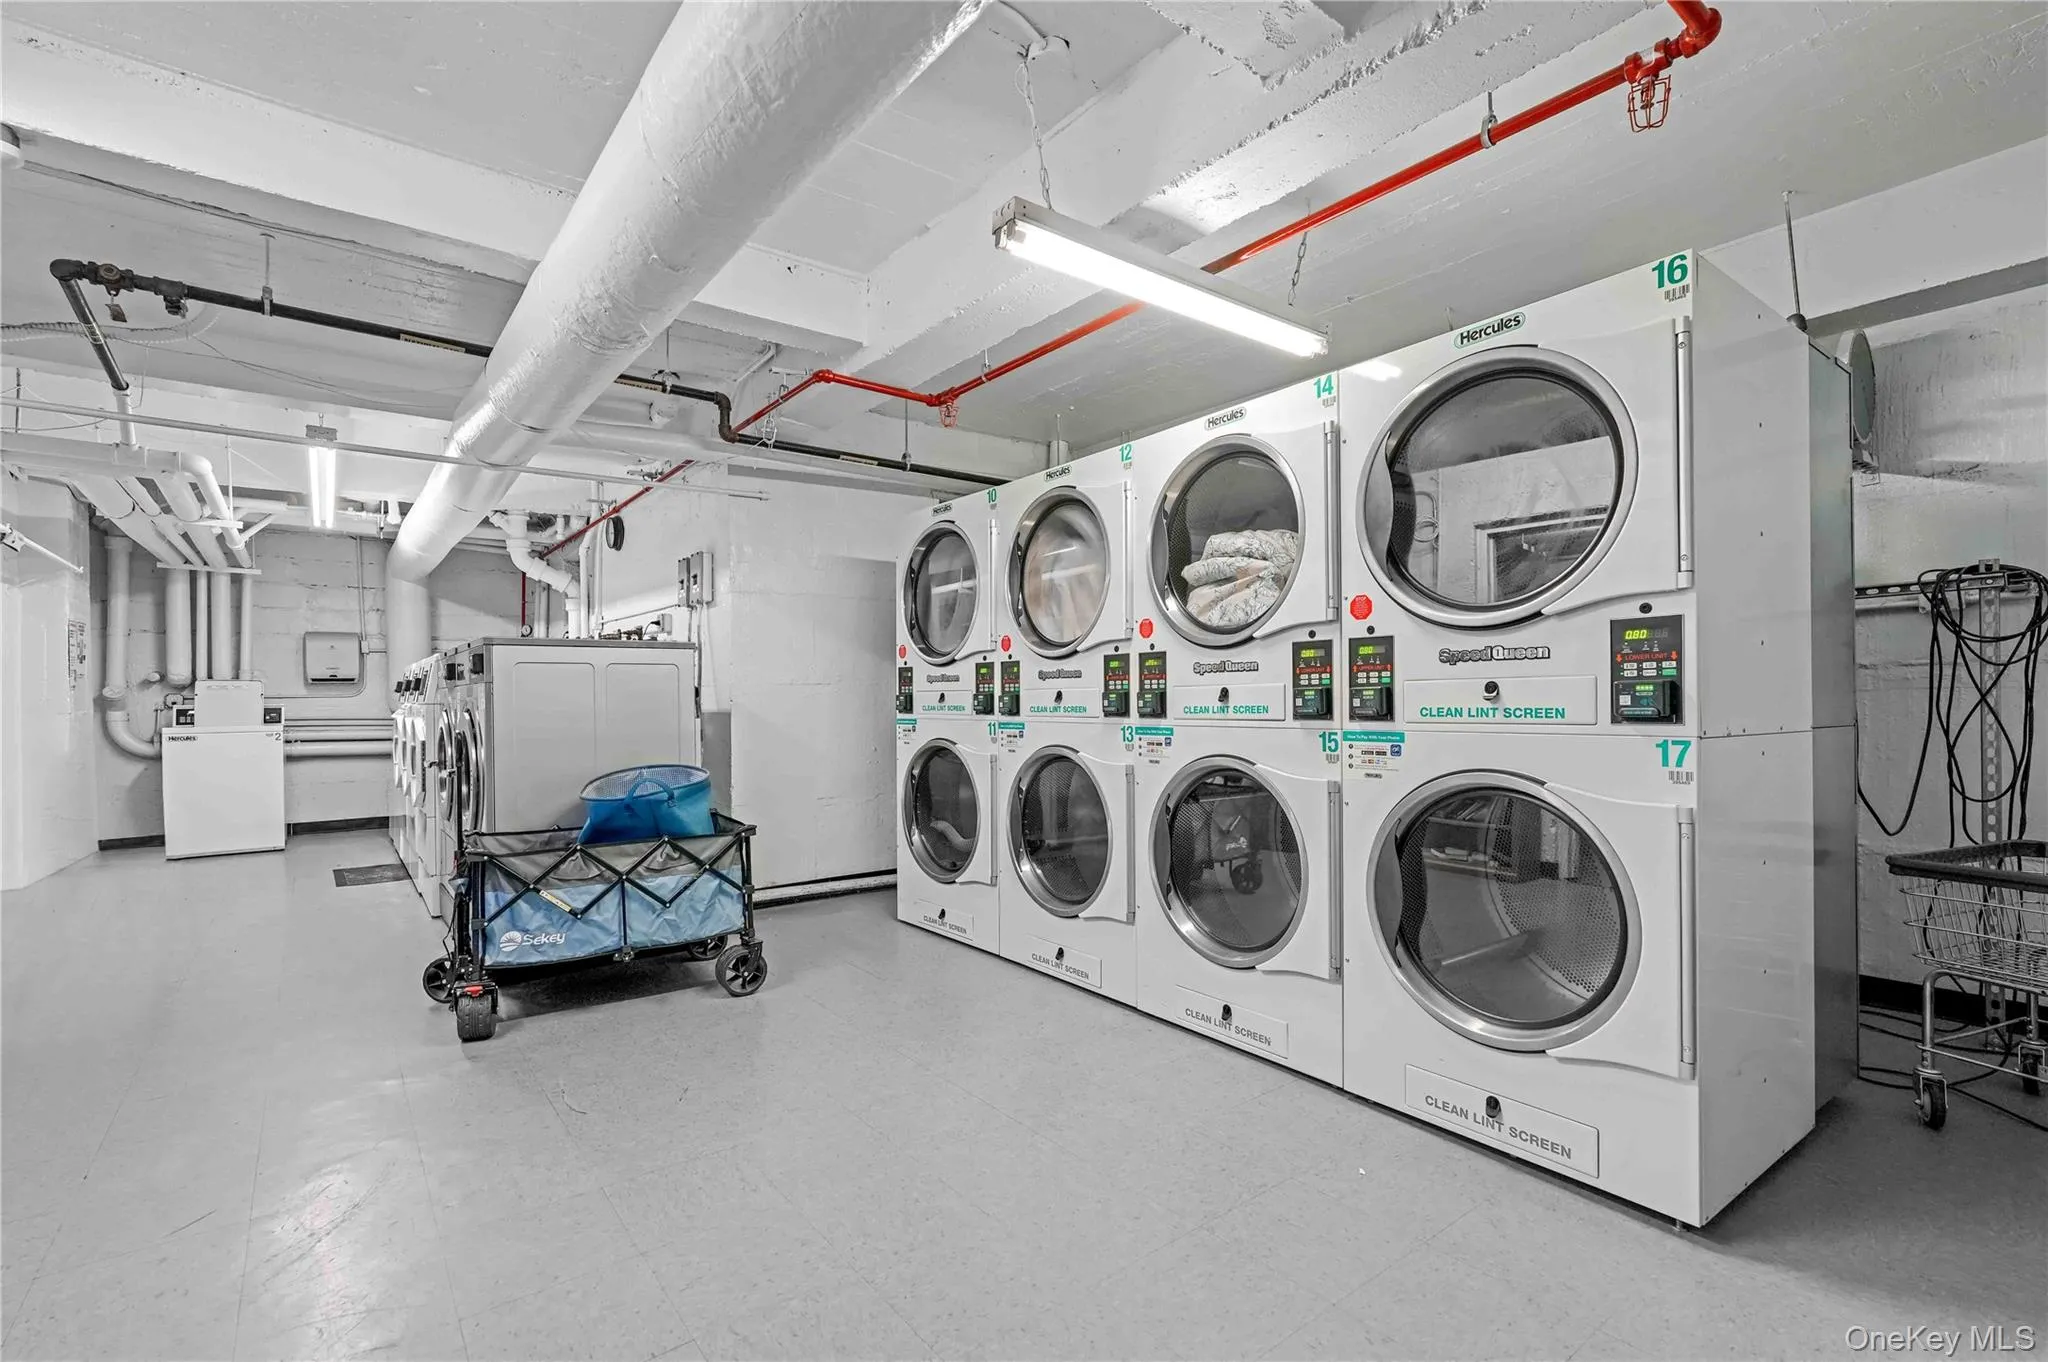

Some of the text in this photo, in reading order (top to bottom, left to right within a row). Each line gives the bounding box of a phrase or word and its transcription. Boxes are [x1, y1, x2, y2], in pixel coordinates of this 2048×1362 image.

[1651, 254, 1688, 289] 16
[1460, 315, 1521, 345] Hercules
[1313, 374, 1334, 399] 14
[1207, 408, 1244, 428] Hercules
[1119, 443, 1132, 462] 12
[1045, 466, 1071, 480] Hercules
[987, 488, 997, 503] 10
[1625, 652, 1668, 661] LOWER UNIT
[922, 704, 936, 712] CLEAN
[947, 704, 966, 712] SCREEN
[1029, 705, 1087, 713] CLEAN LINT SCREEN
[1183, 705, 1269, 714] CLEAN LINT SCREEN
[1419, 706, 1566, 719] CLEAN LINT SCREEN
[274, 732, 282, 741] 2
[988, 722, 997, 736] 11
[1120, 725, 1134, 743] 13
[1318, 731, 1339, 753] 15
[1655, 739, 1692, 768] 17
[521, 932, 567, 946] Sekey
[1031, 953, 1089, 979] CLEAN LINT SCREEN
[1185, 1008, 1272, 1046] CLEAN LINT SCREEN
[1425, 1095, 1572, 1160] CLEAN LINT SCREEN
